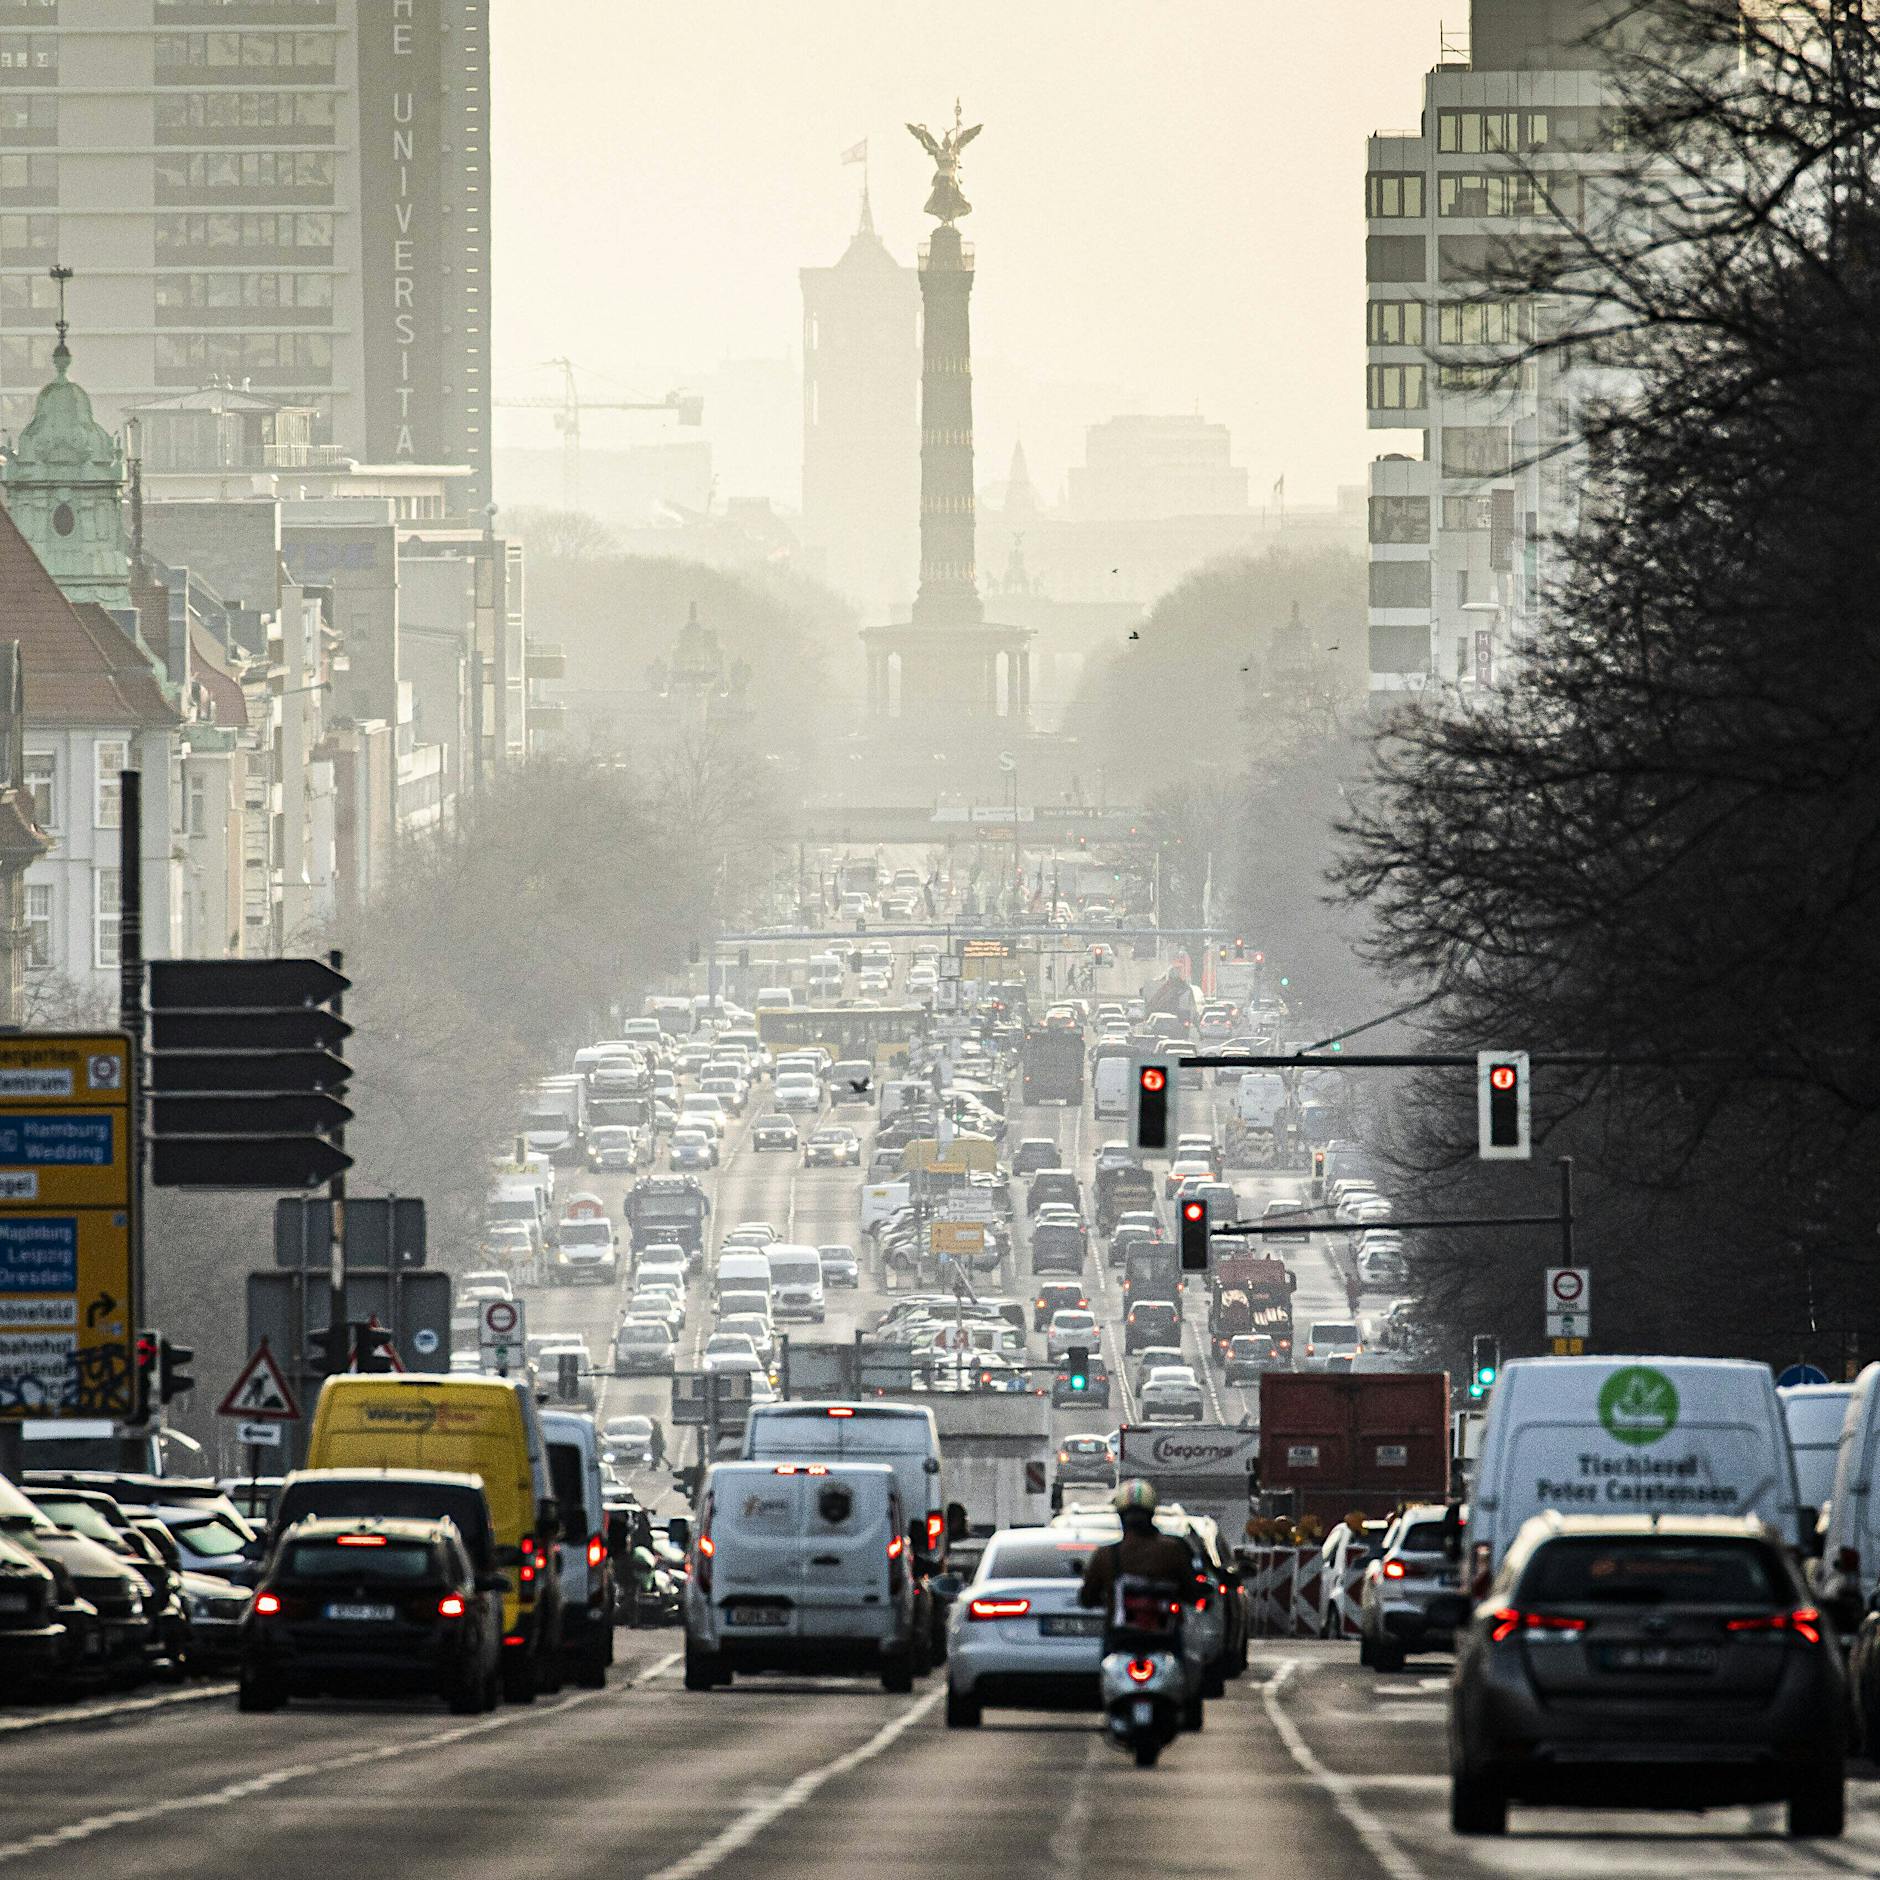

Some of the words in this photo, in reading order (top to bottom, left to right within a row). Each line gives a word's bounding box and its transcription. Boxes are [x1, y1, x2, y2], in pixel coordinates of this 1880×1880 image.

[394, 93, 415, 464] UNIVERSITÄ
[23, 1121, 108, 1142] Hamburg
[25, 1143, 104, 1163] Wedding
[8, 1247, 73, 1266] Leipzig
[1578, 1453, 1698, 1477] Tischlerei
[1536, 1478, 1598, 1502] Peter
